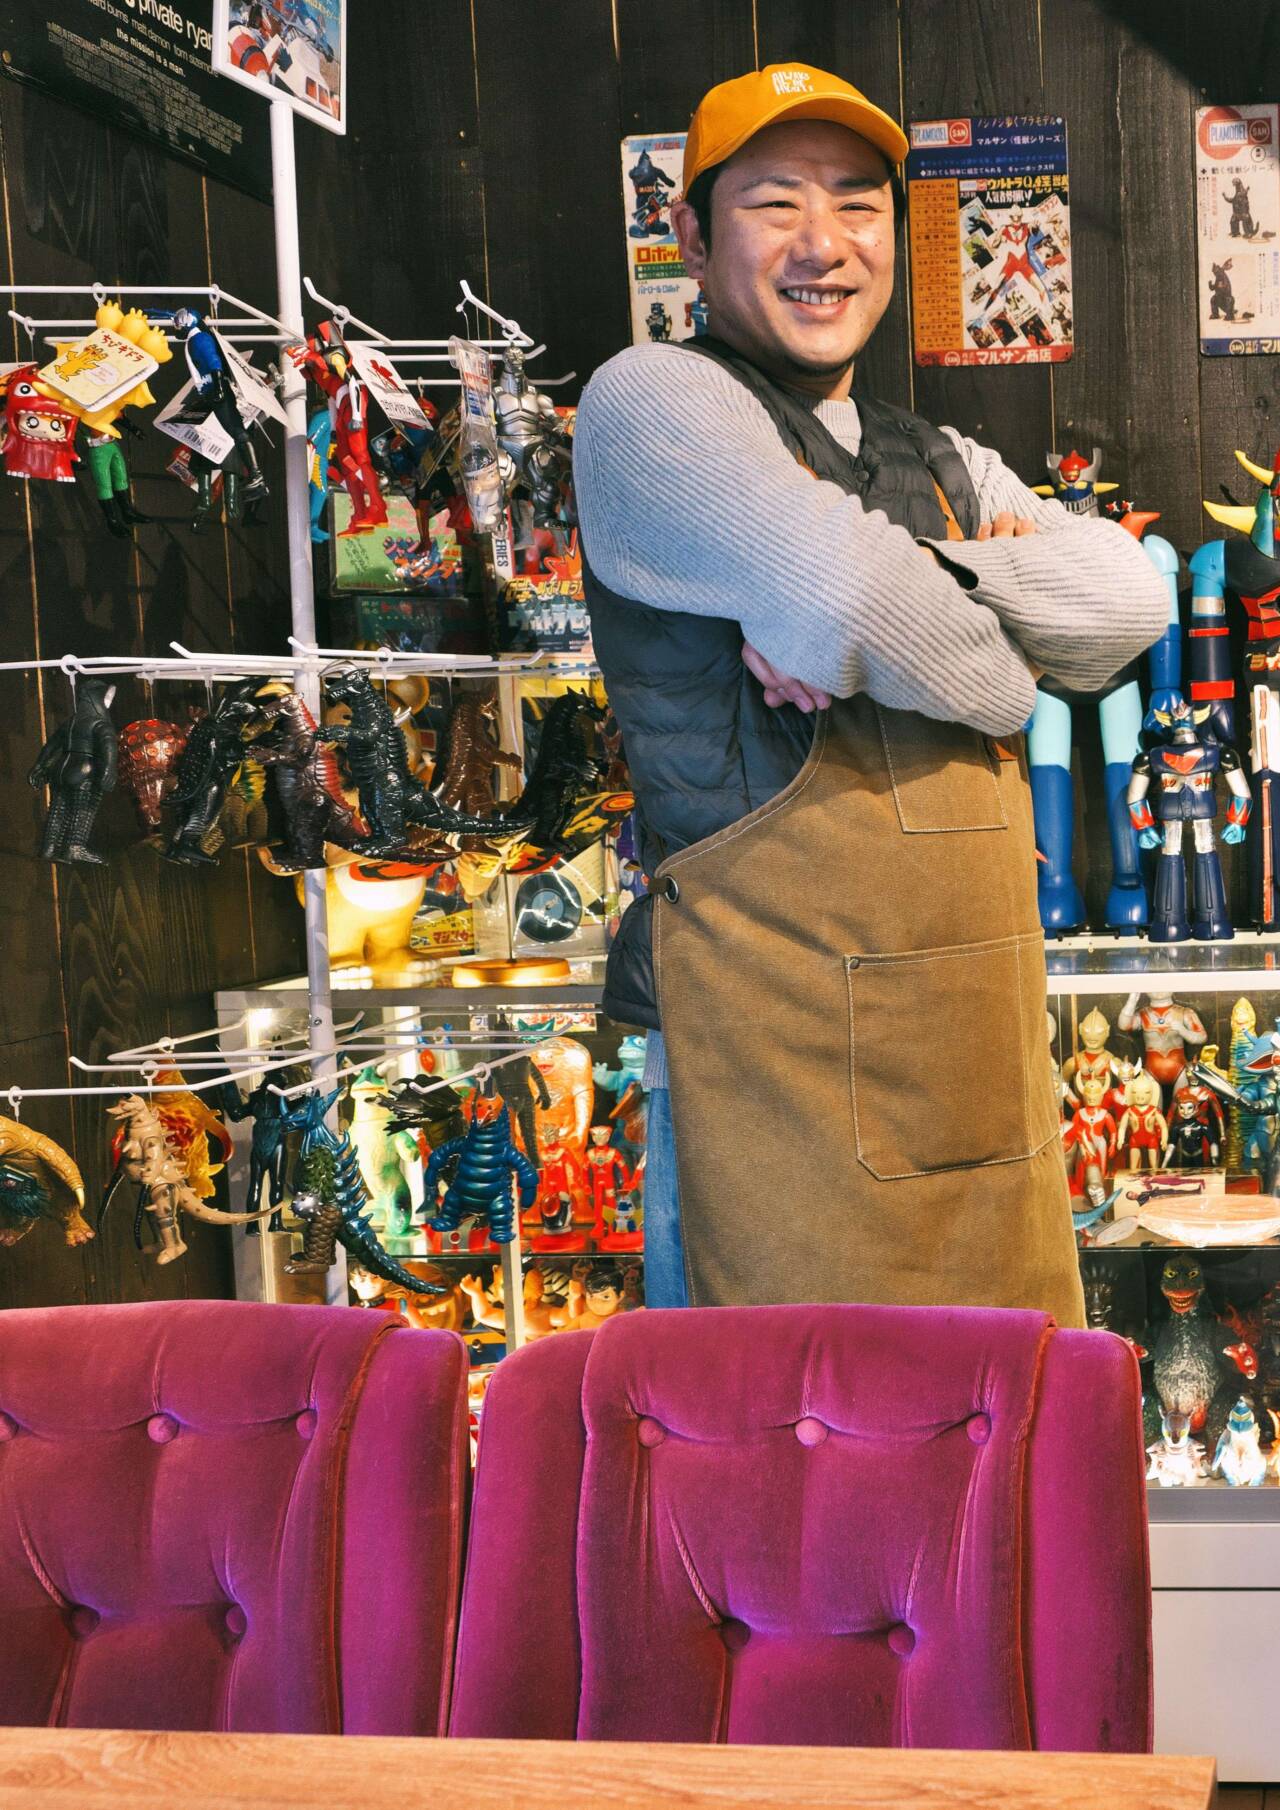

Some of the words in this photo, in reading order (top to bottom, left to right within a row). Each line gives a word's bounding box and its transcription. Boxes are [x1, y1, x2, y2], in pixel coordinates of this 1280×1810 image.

[139, 0, 183, 33] private
[116, 27, 129, 42] the
[130, 37, 155, 60] mission
[101, 333, 145, 363] ちびギドラ
[976, 348, 1052, 364] マルサン商店
